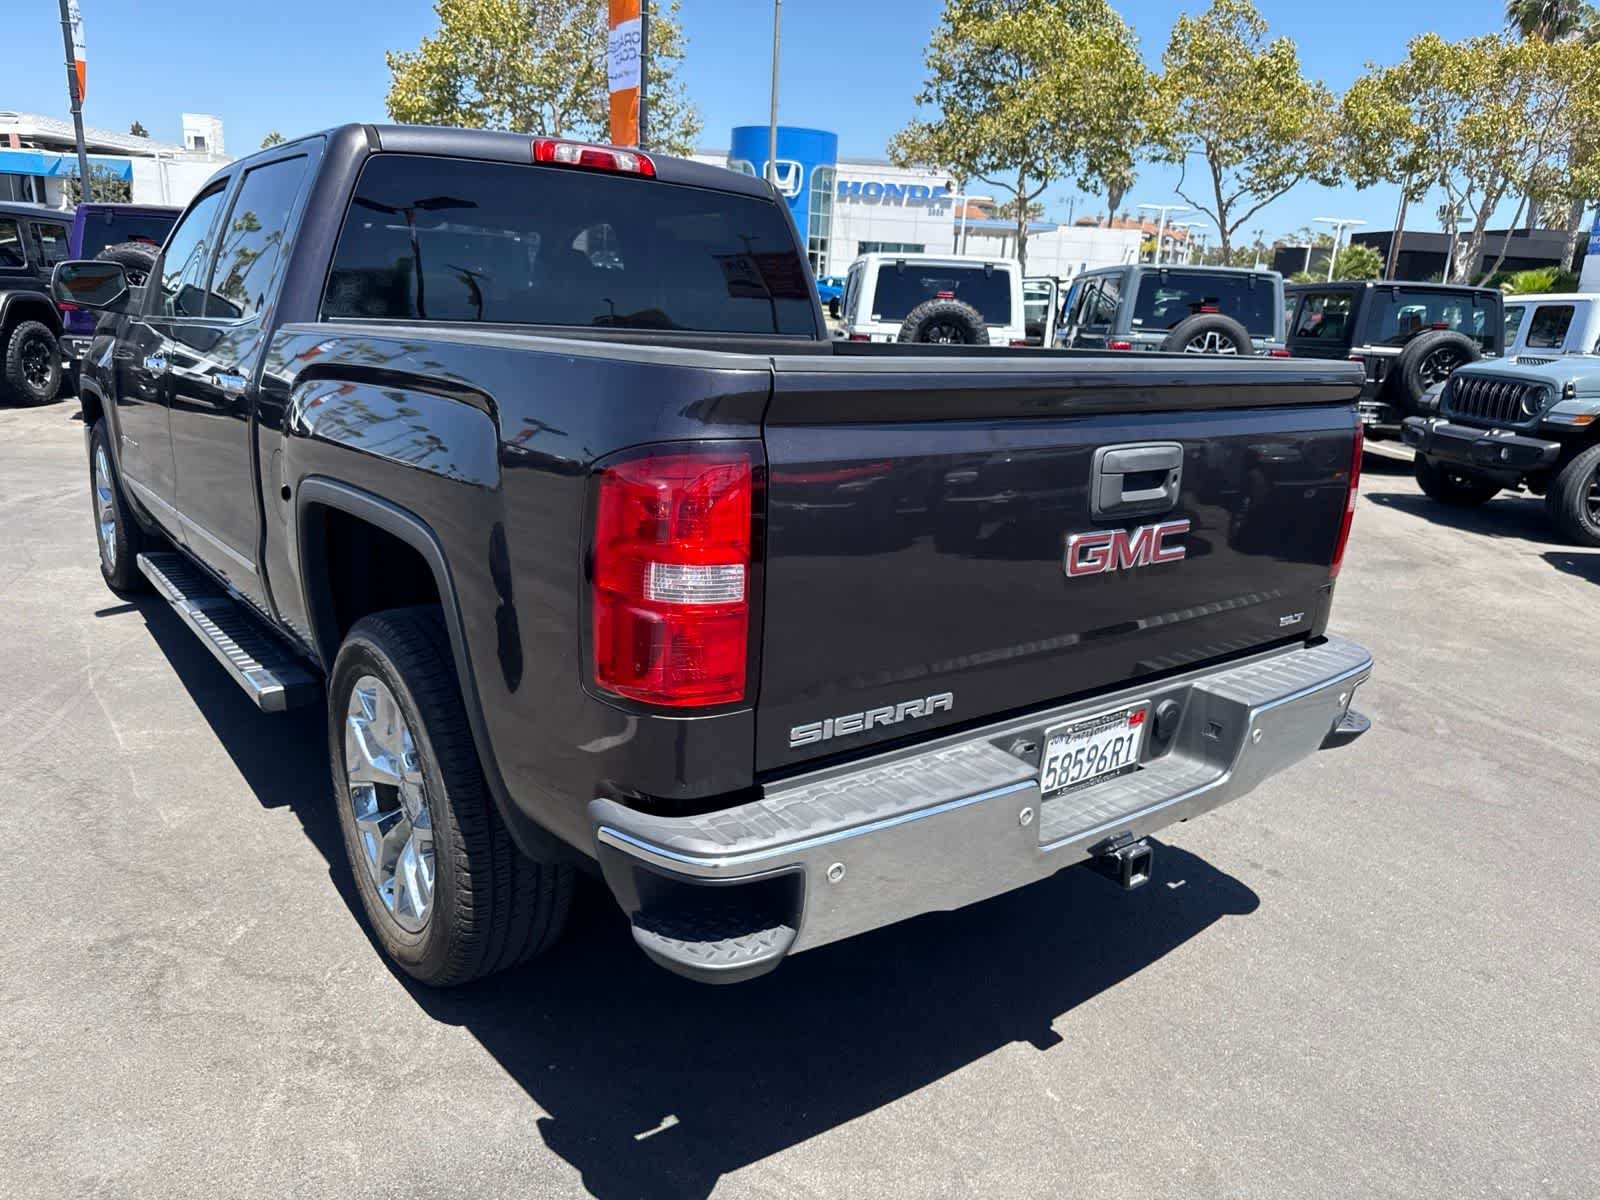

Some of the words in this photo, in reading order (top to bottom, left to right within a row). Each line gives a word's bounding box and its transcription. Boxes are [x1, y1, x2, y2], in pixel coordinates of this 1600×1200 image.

[836, 180, 954, 209] HONDA
[1065, 519, 1191, 577] GMC
[789, 692, 954, 748] SIERRA
[1044, 733, 1135, 790] 58596R1
